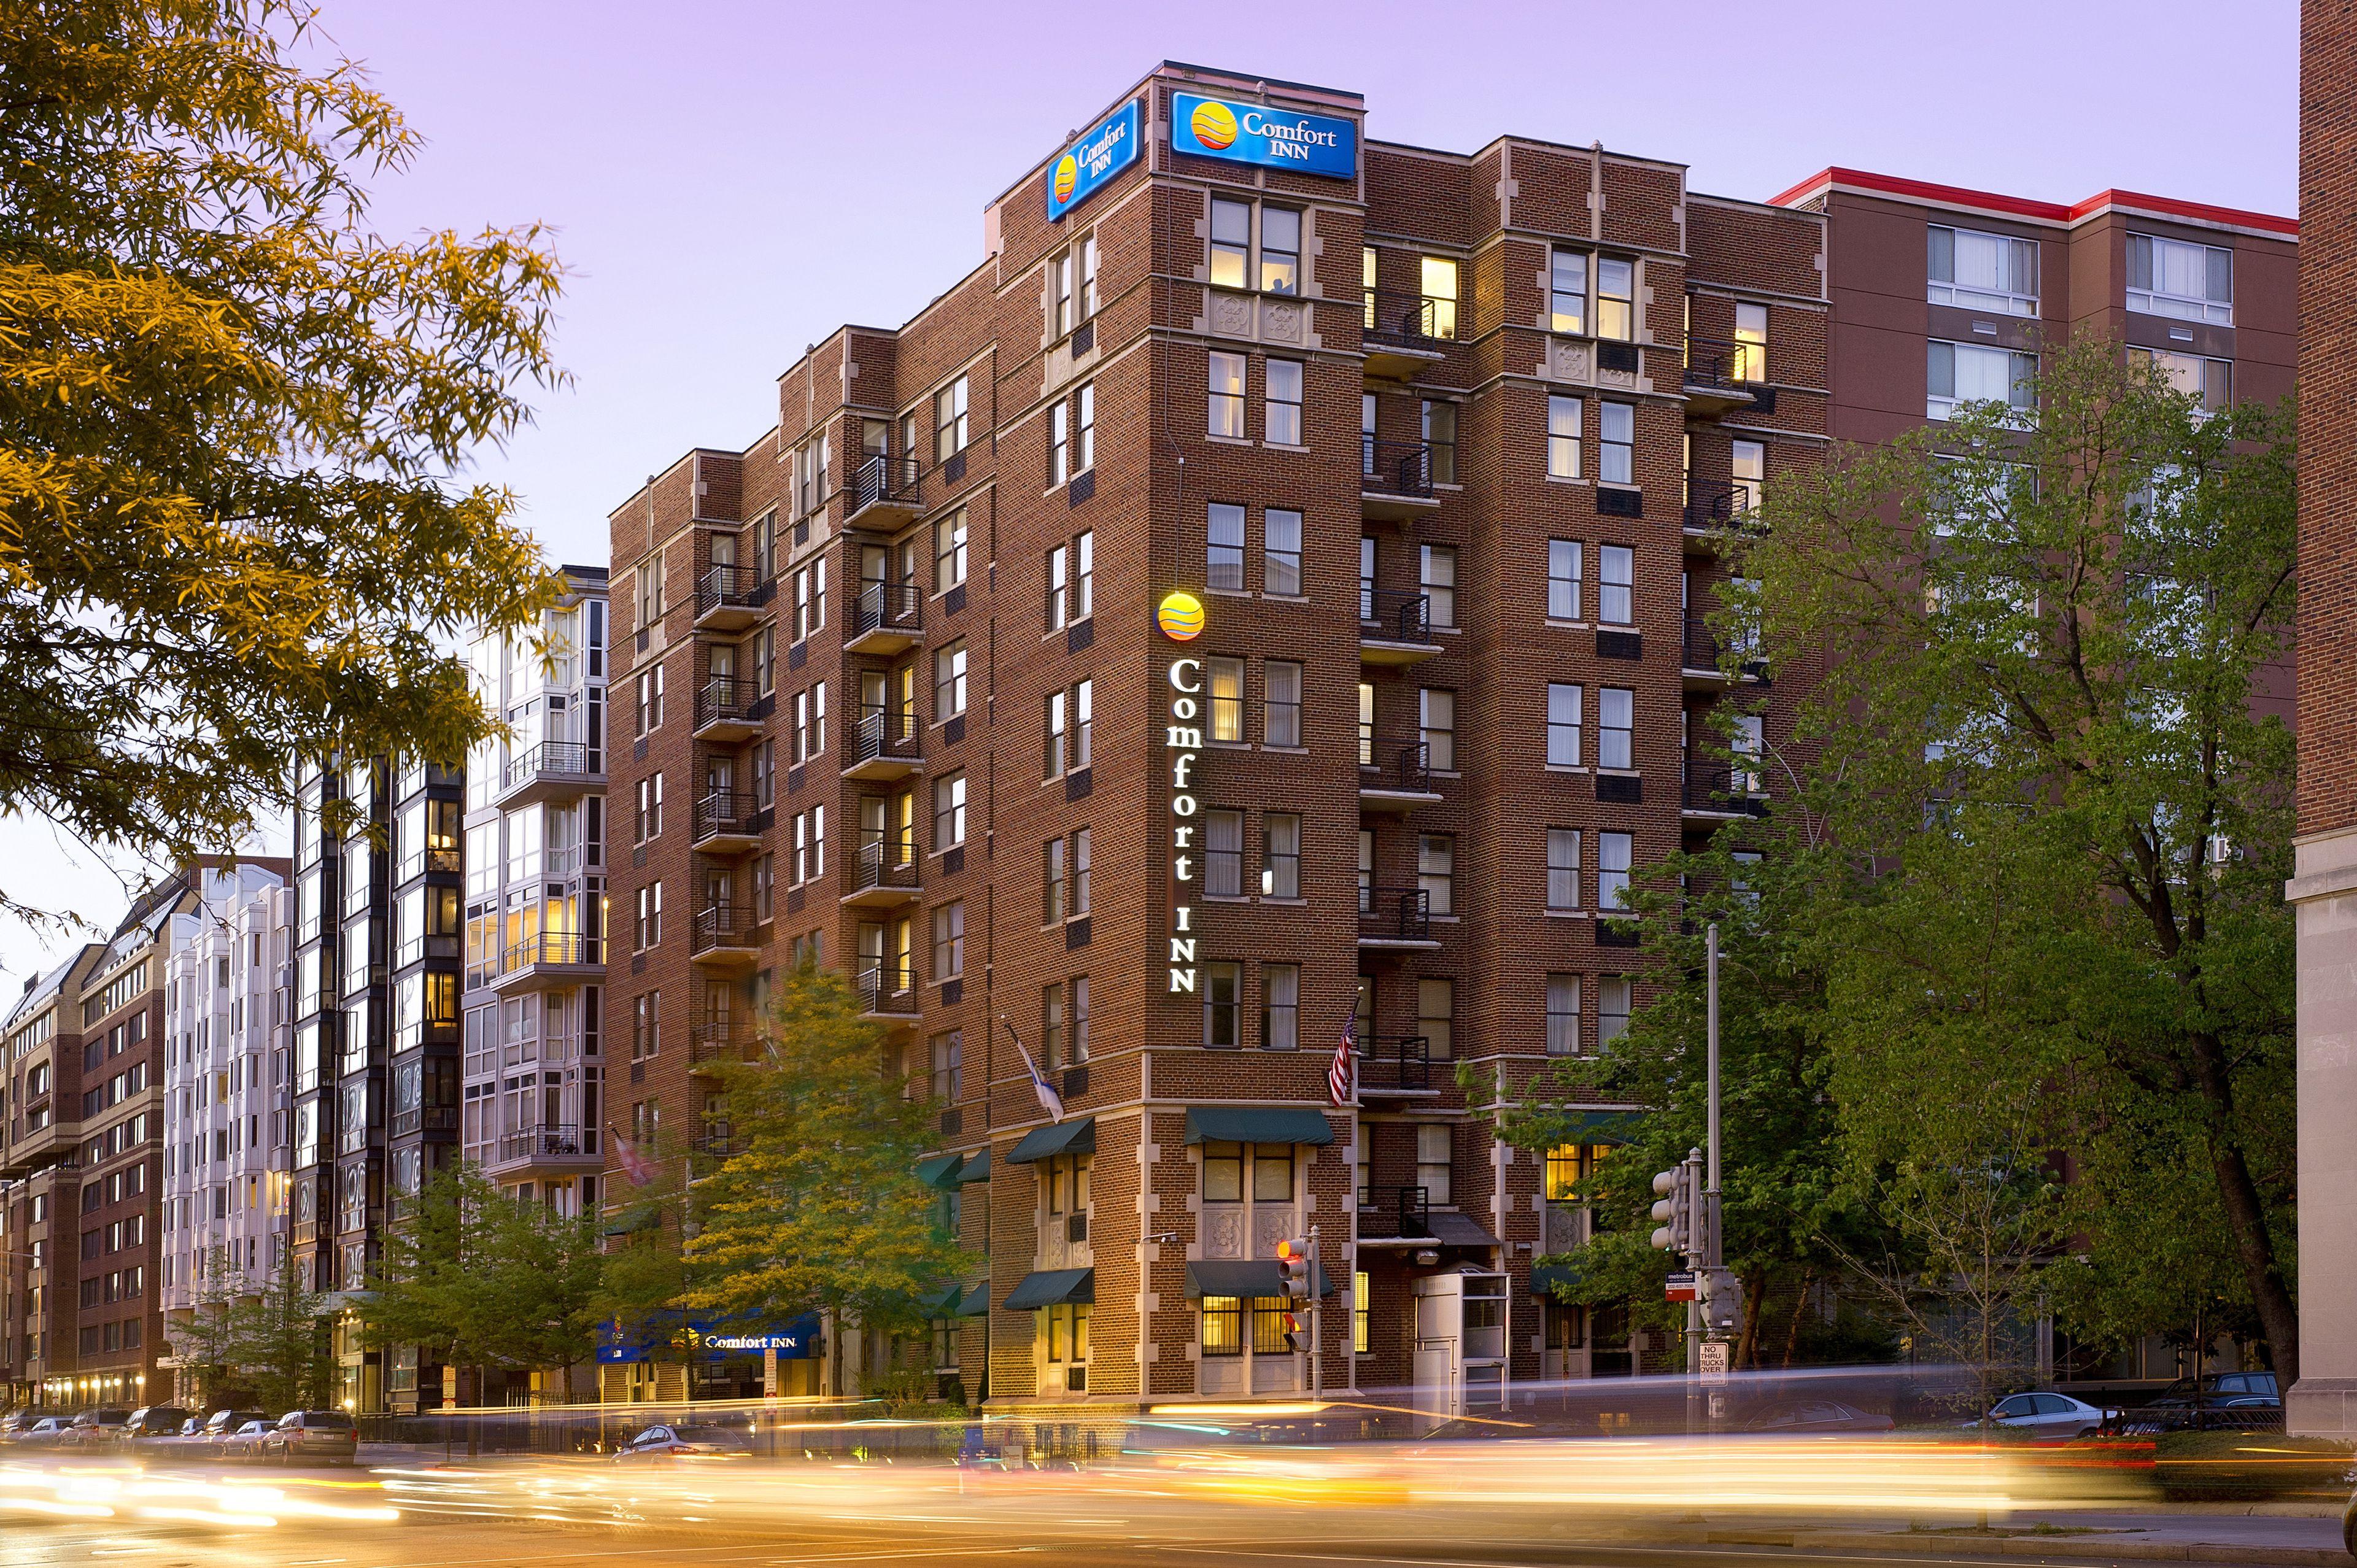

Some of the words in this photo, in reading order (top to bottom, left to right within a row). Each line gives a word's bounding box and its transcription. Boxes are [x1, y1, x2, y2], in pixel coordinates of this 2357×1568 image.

[1078, 121, 1126, 168] Comfort
[1243, 112, 1337, 147] Comfort
[1091, 149, 1112, 179] INN
[1270, 140, 1310, 161] INN
[1167, 659, 1202, 881] Comfort
[1171, 907, 1196, 992] INN
[705, 1334, 768, 1348] Comfort
